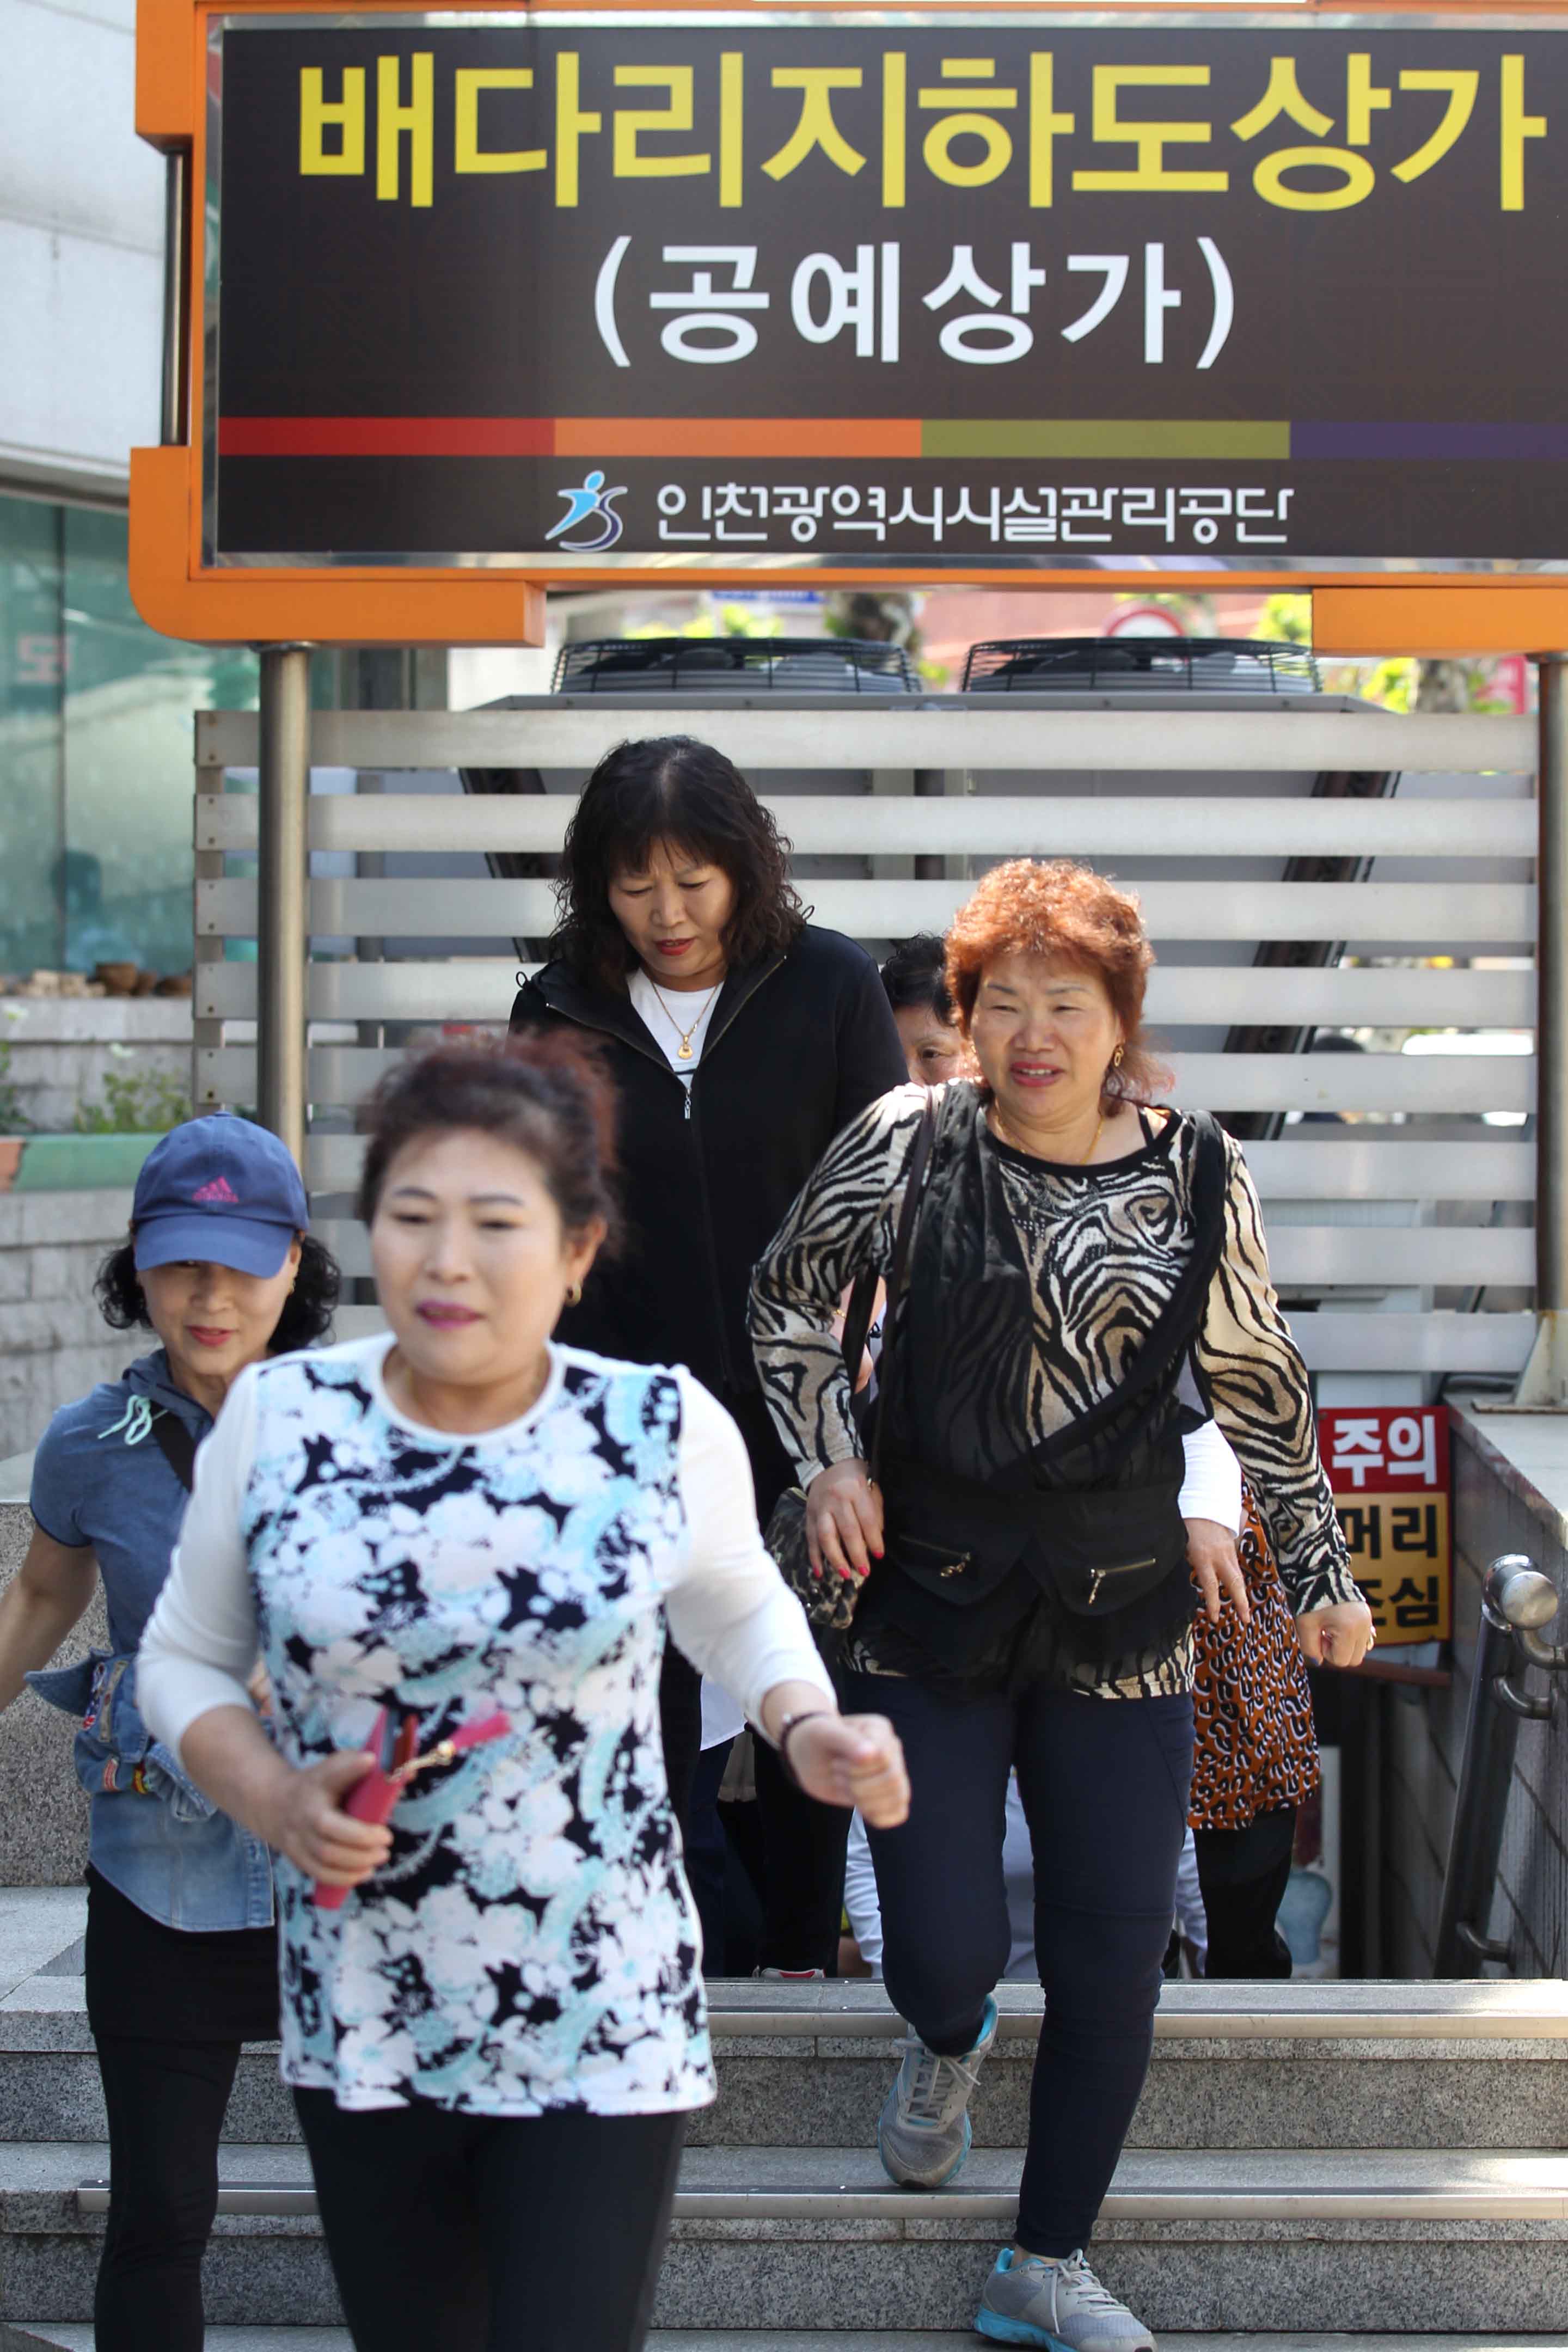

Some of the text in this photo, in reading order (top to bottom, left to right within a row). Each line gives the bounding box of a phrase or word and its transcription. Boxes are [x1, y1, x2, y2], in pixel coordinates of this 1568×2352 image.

[300, 52, 1547, 211] 배다리지하도상가
[595, 236, 1234, 369] (공예상가)
[657, 482, 1295, 544] 인천광역시시설관리공단
[1331, 1415, 1437, 1487] 주의
[1336, 1504, 1438, 1559] 머리
